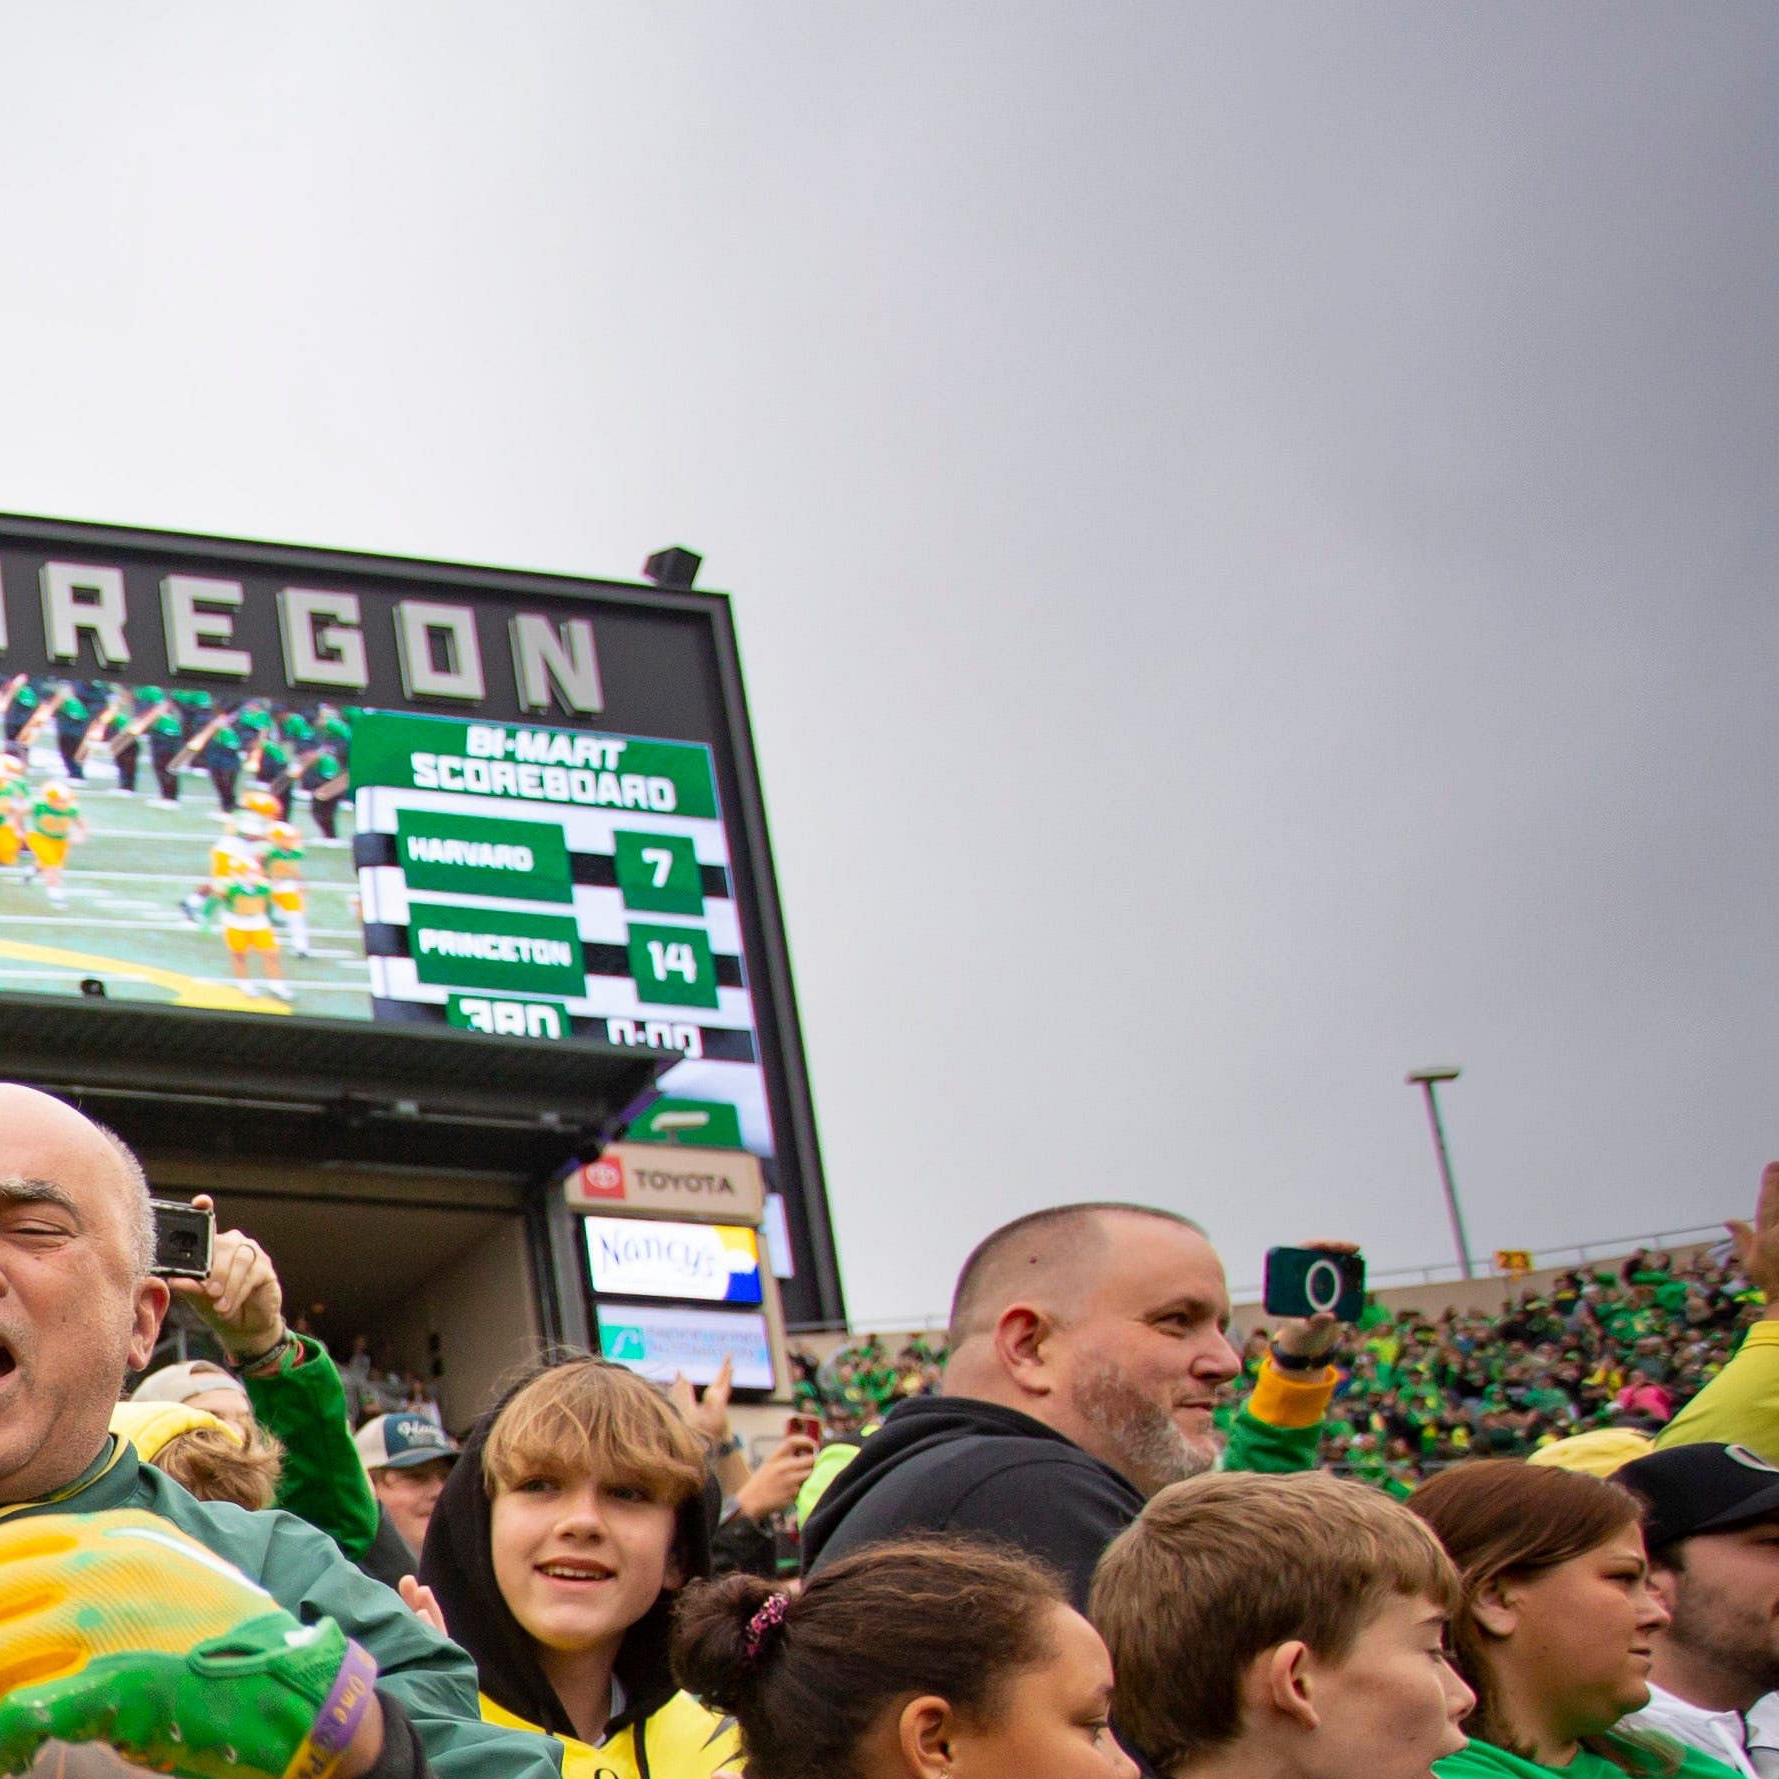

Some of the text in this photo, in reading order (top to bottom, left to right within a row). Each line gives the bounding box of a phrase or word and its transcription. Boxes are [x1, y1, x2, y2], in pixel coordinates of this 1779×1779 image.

[409, 751, 677, 813] SCOREBOARD
[406, 835, 535, 873] HARVARD
[640, 847, 674, 889] 7
[417, 927, 573, 968] PRINCETON
[646, 940, 698, 985] 14
[632, 1168, 736, 1198] TOYOTA
